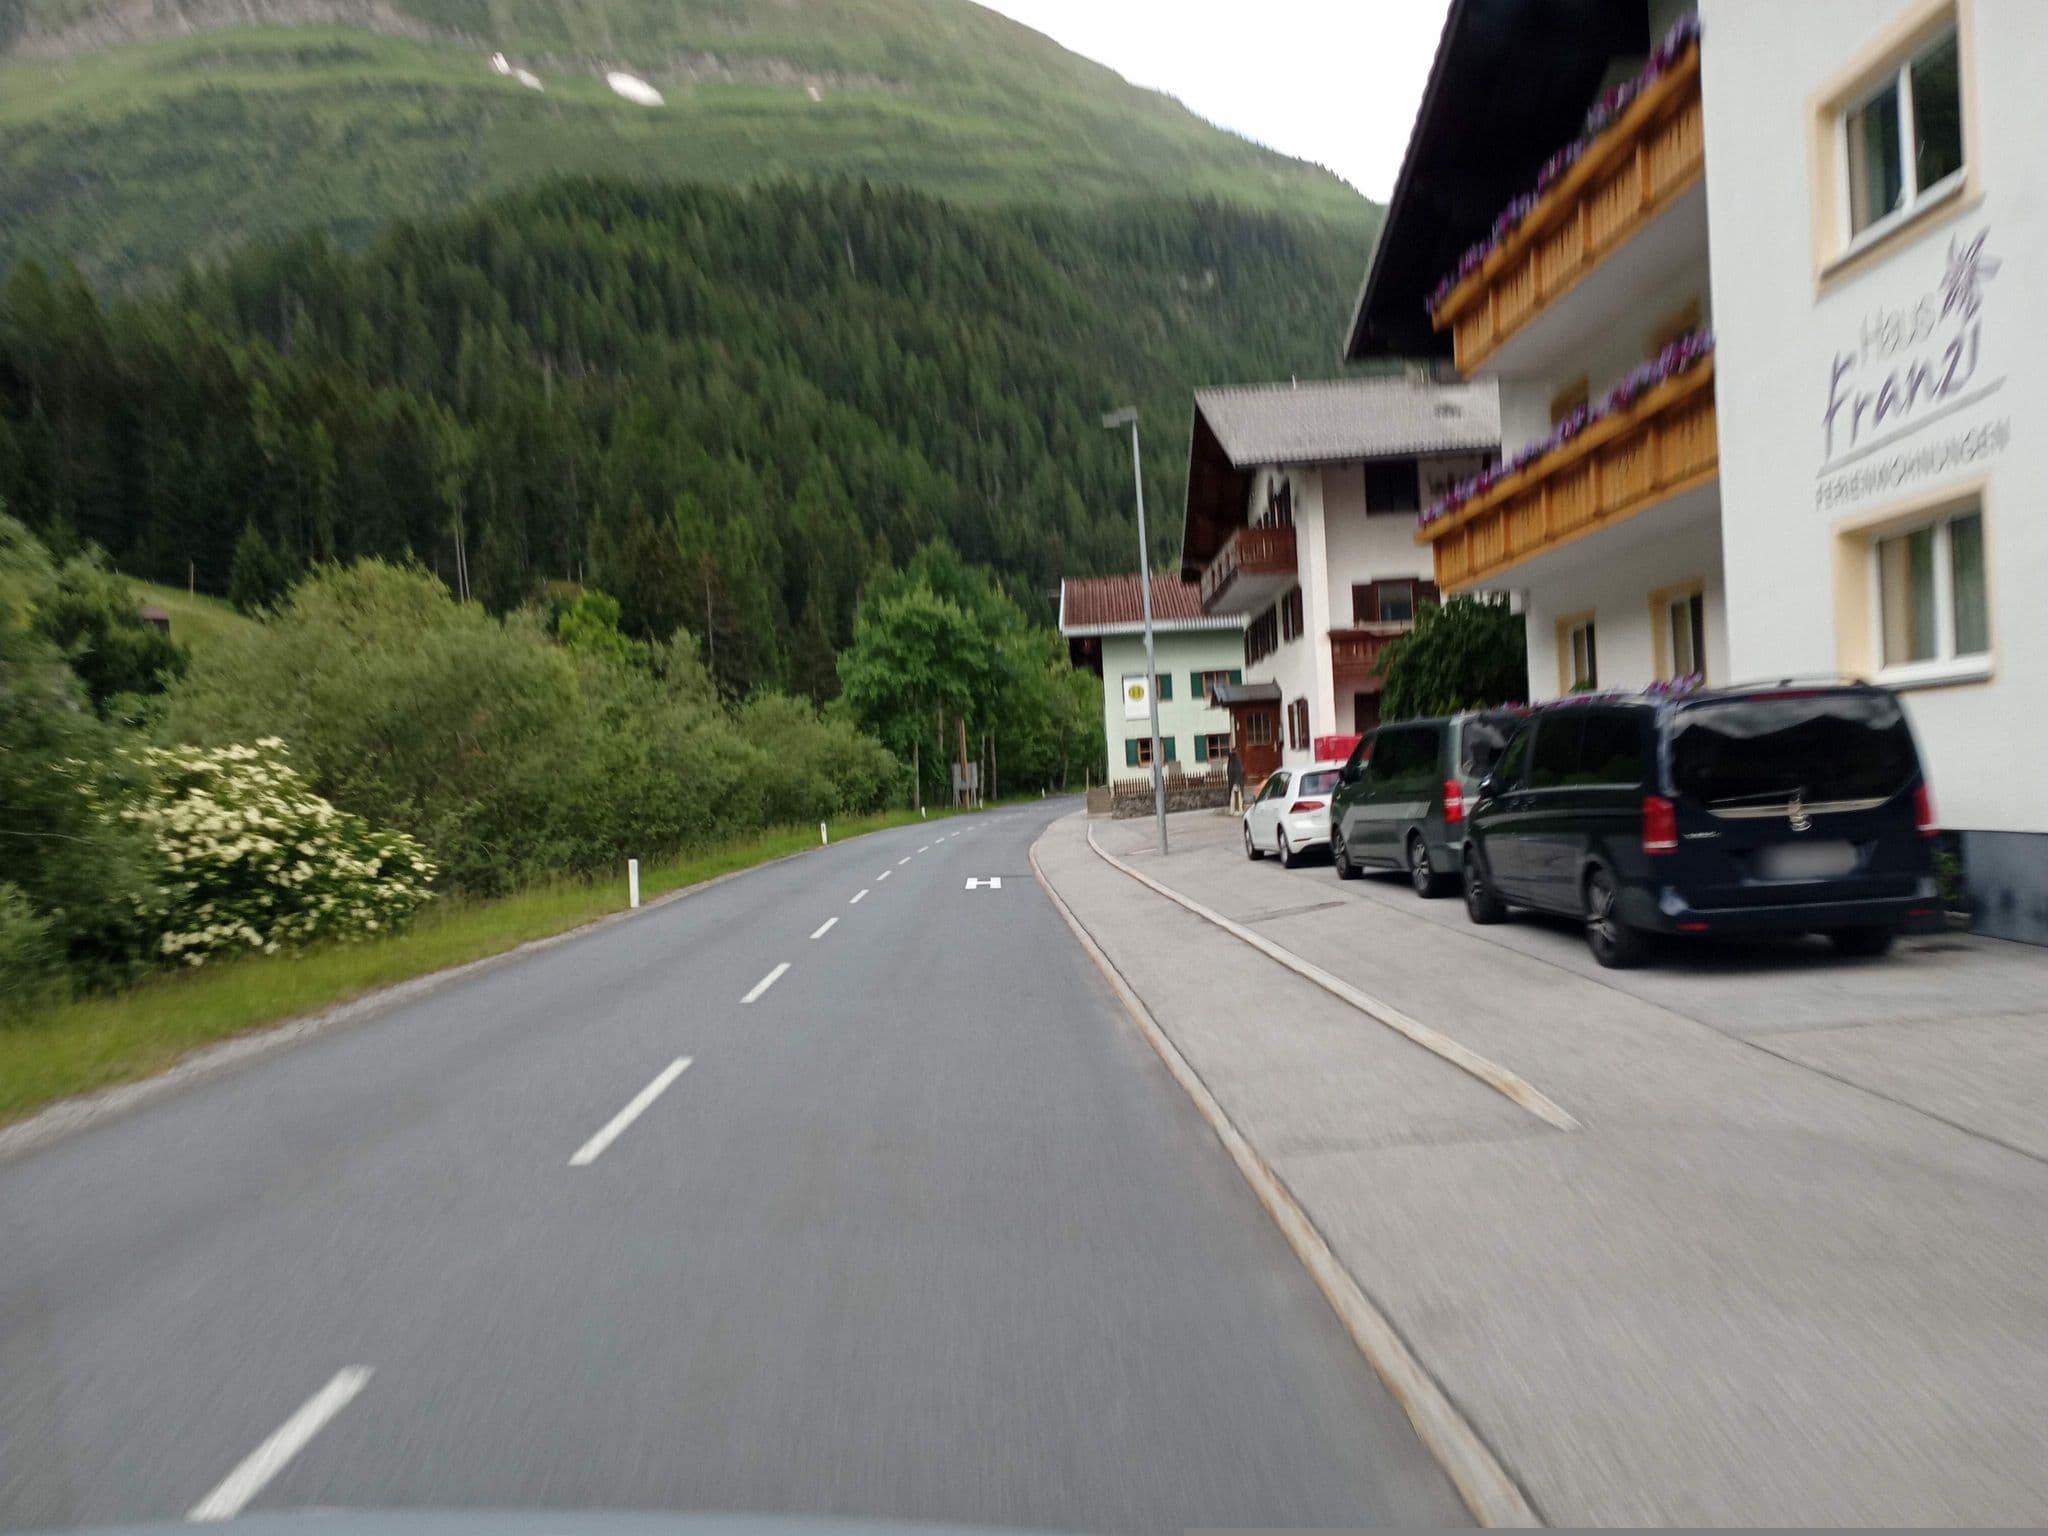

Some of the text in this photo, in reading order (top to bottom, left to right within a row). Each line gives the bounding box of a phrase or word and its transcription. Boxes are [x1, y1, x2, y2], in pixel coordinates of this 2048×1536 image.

[1860, 294, 1937, 365] Haus
[1823, 319, 1981, 462] Franzl
[1815, 417, 2010, 510] FERIENWOHNUNGEN
